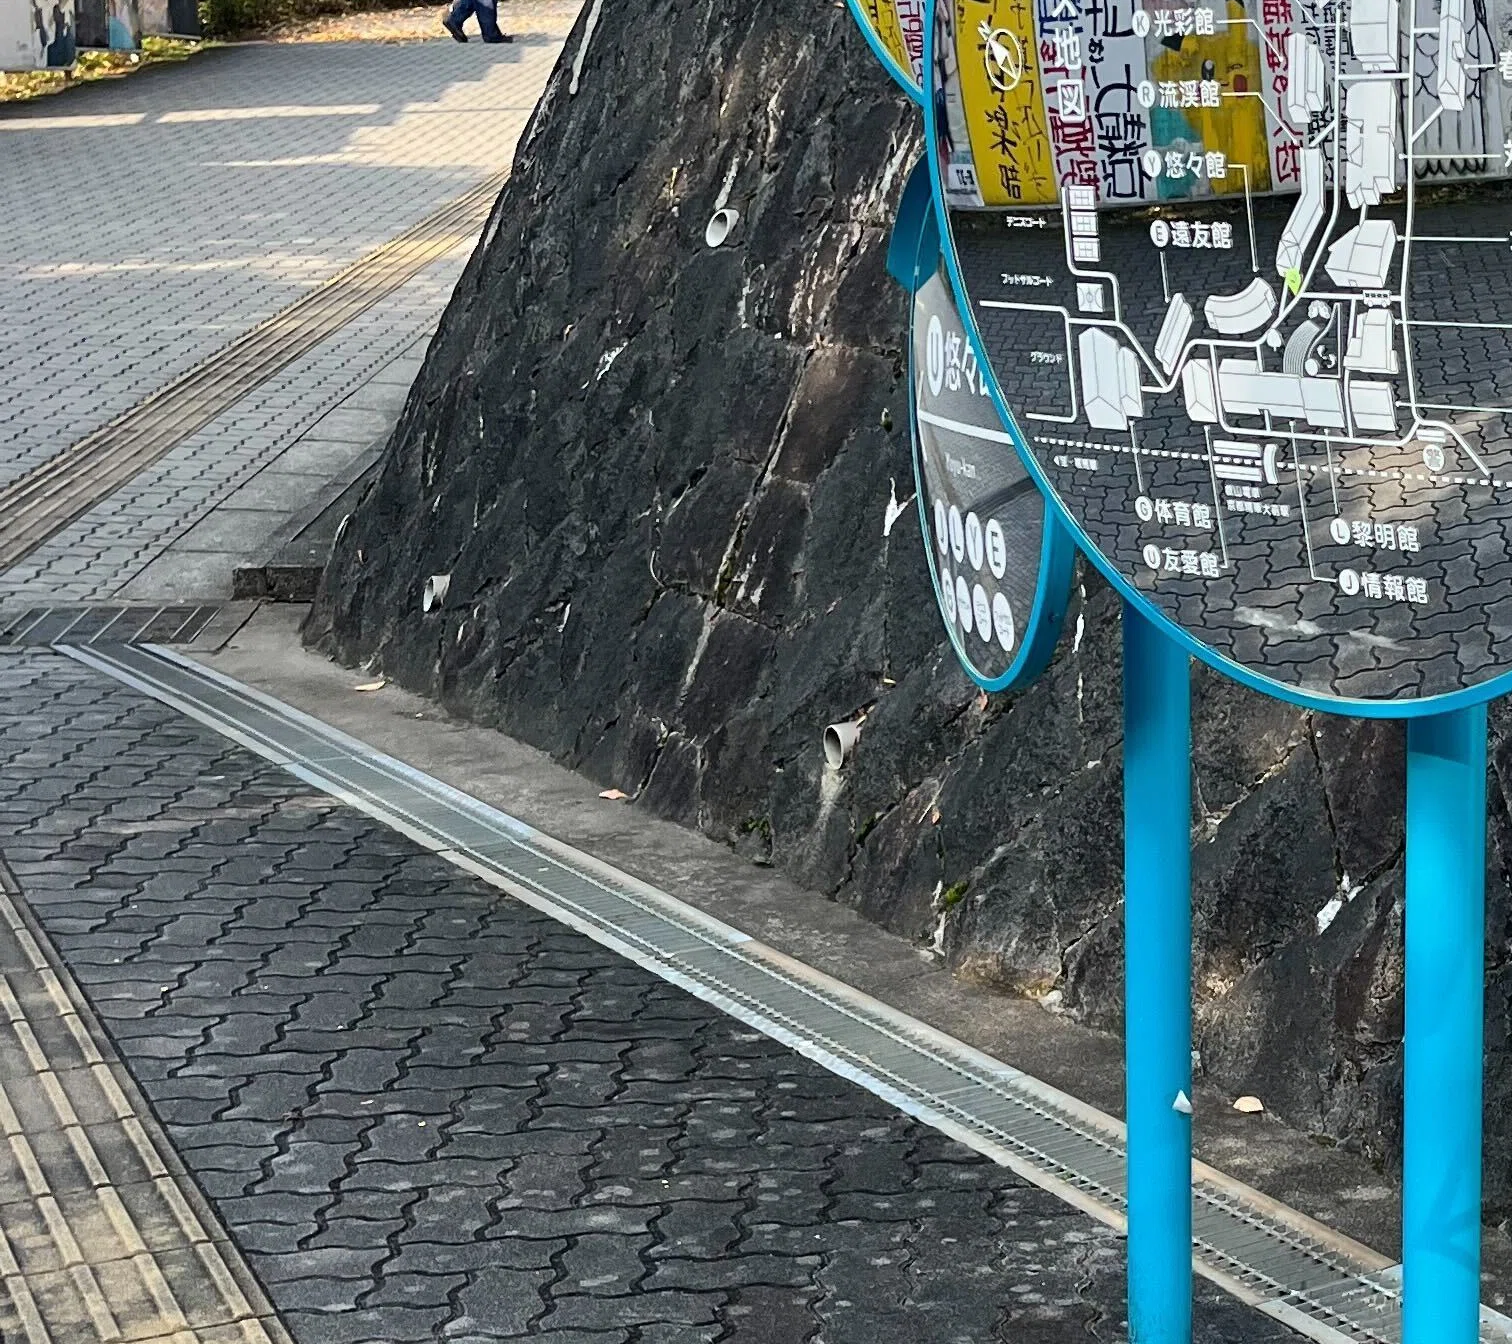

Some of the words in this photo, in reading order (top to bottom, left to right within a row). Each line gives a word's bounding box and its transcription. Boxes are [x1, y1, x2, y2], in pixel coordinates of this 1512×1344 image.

[1154, 7, 1214, 37] 光彩館
[1158, 79, 1221, 108] 流渓館
[1164, 152, 1227, 179] 悠々館
[1170, 221, 1233, 249] 遠友館
[945, 331, 993, 396] 悠々
[1154, 498, 1213, 530] 体育館
[1351, 521, 1421, 553] 黎明館
[1161, 547, 1221, 578] 友愛館
[1361, 573, 1429, 604] 情報館
